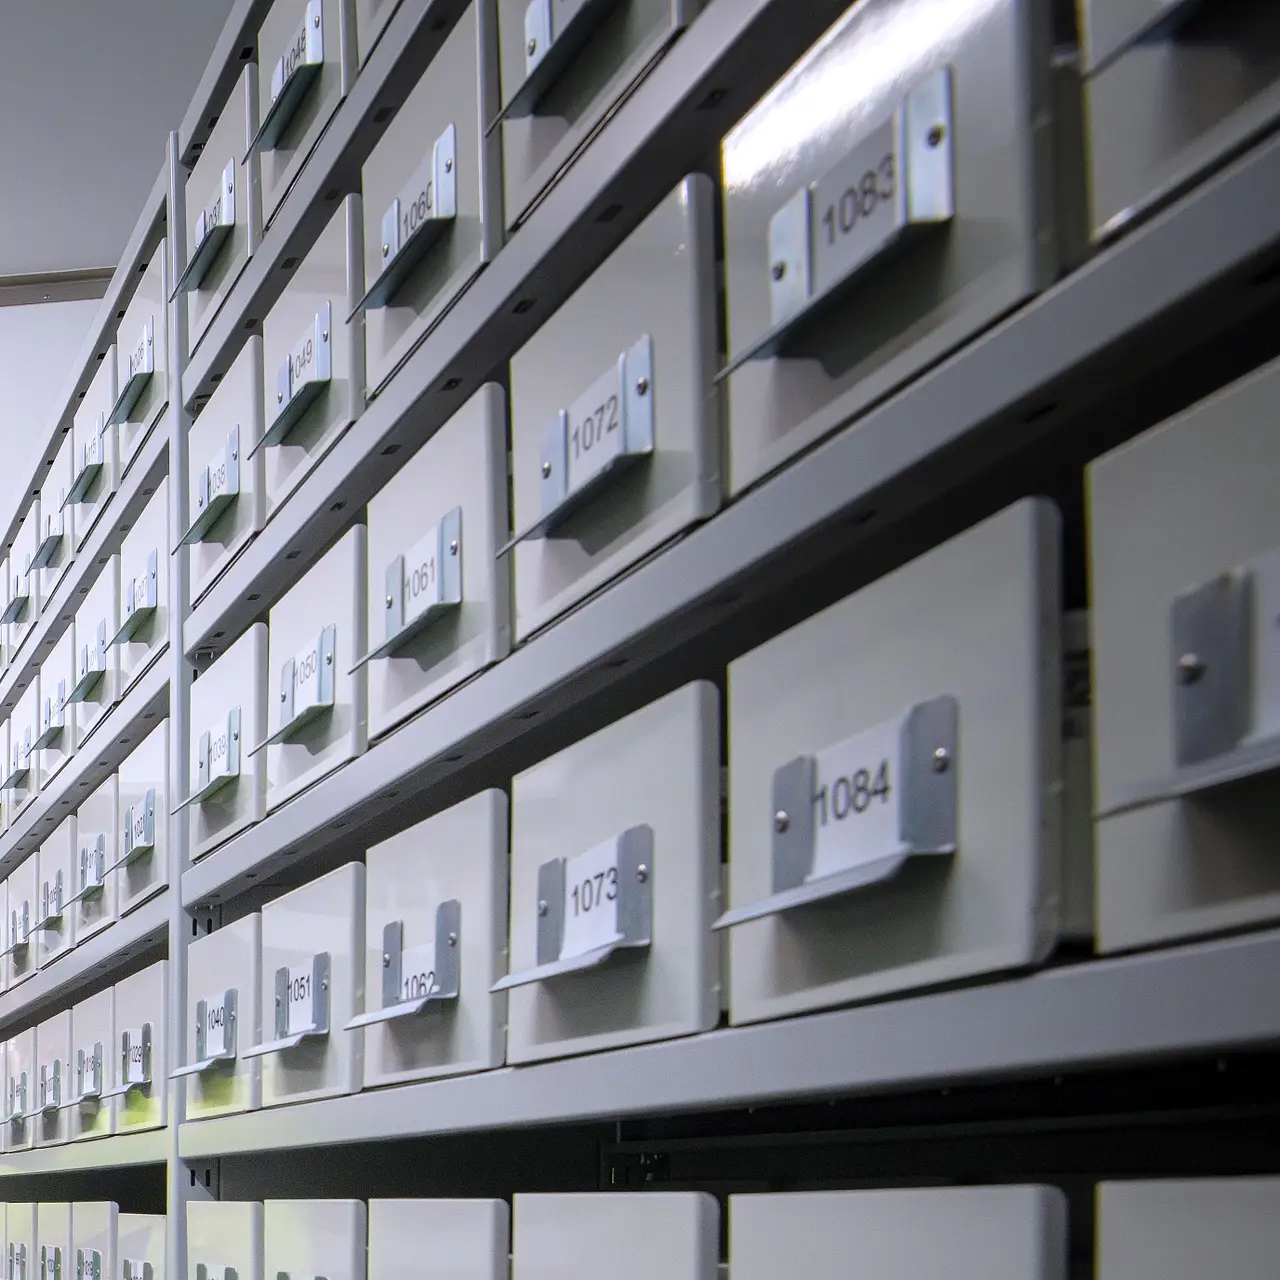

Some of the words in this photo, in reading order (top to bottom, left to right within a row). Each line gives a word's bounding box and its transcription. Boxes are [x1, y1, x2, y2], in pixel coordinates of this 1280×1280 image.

[821, 153, 897, 247] 1083
[571, 393, 619, 460] 1072
[403, 560, 436, 603] 1061
[294, 648, 317, 687] 1050
[810, 759, 891, 828] 1084
[570, 867, 619, 917] 1073
[288, 974, 312, 1003] 1051
